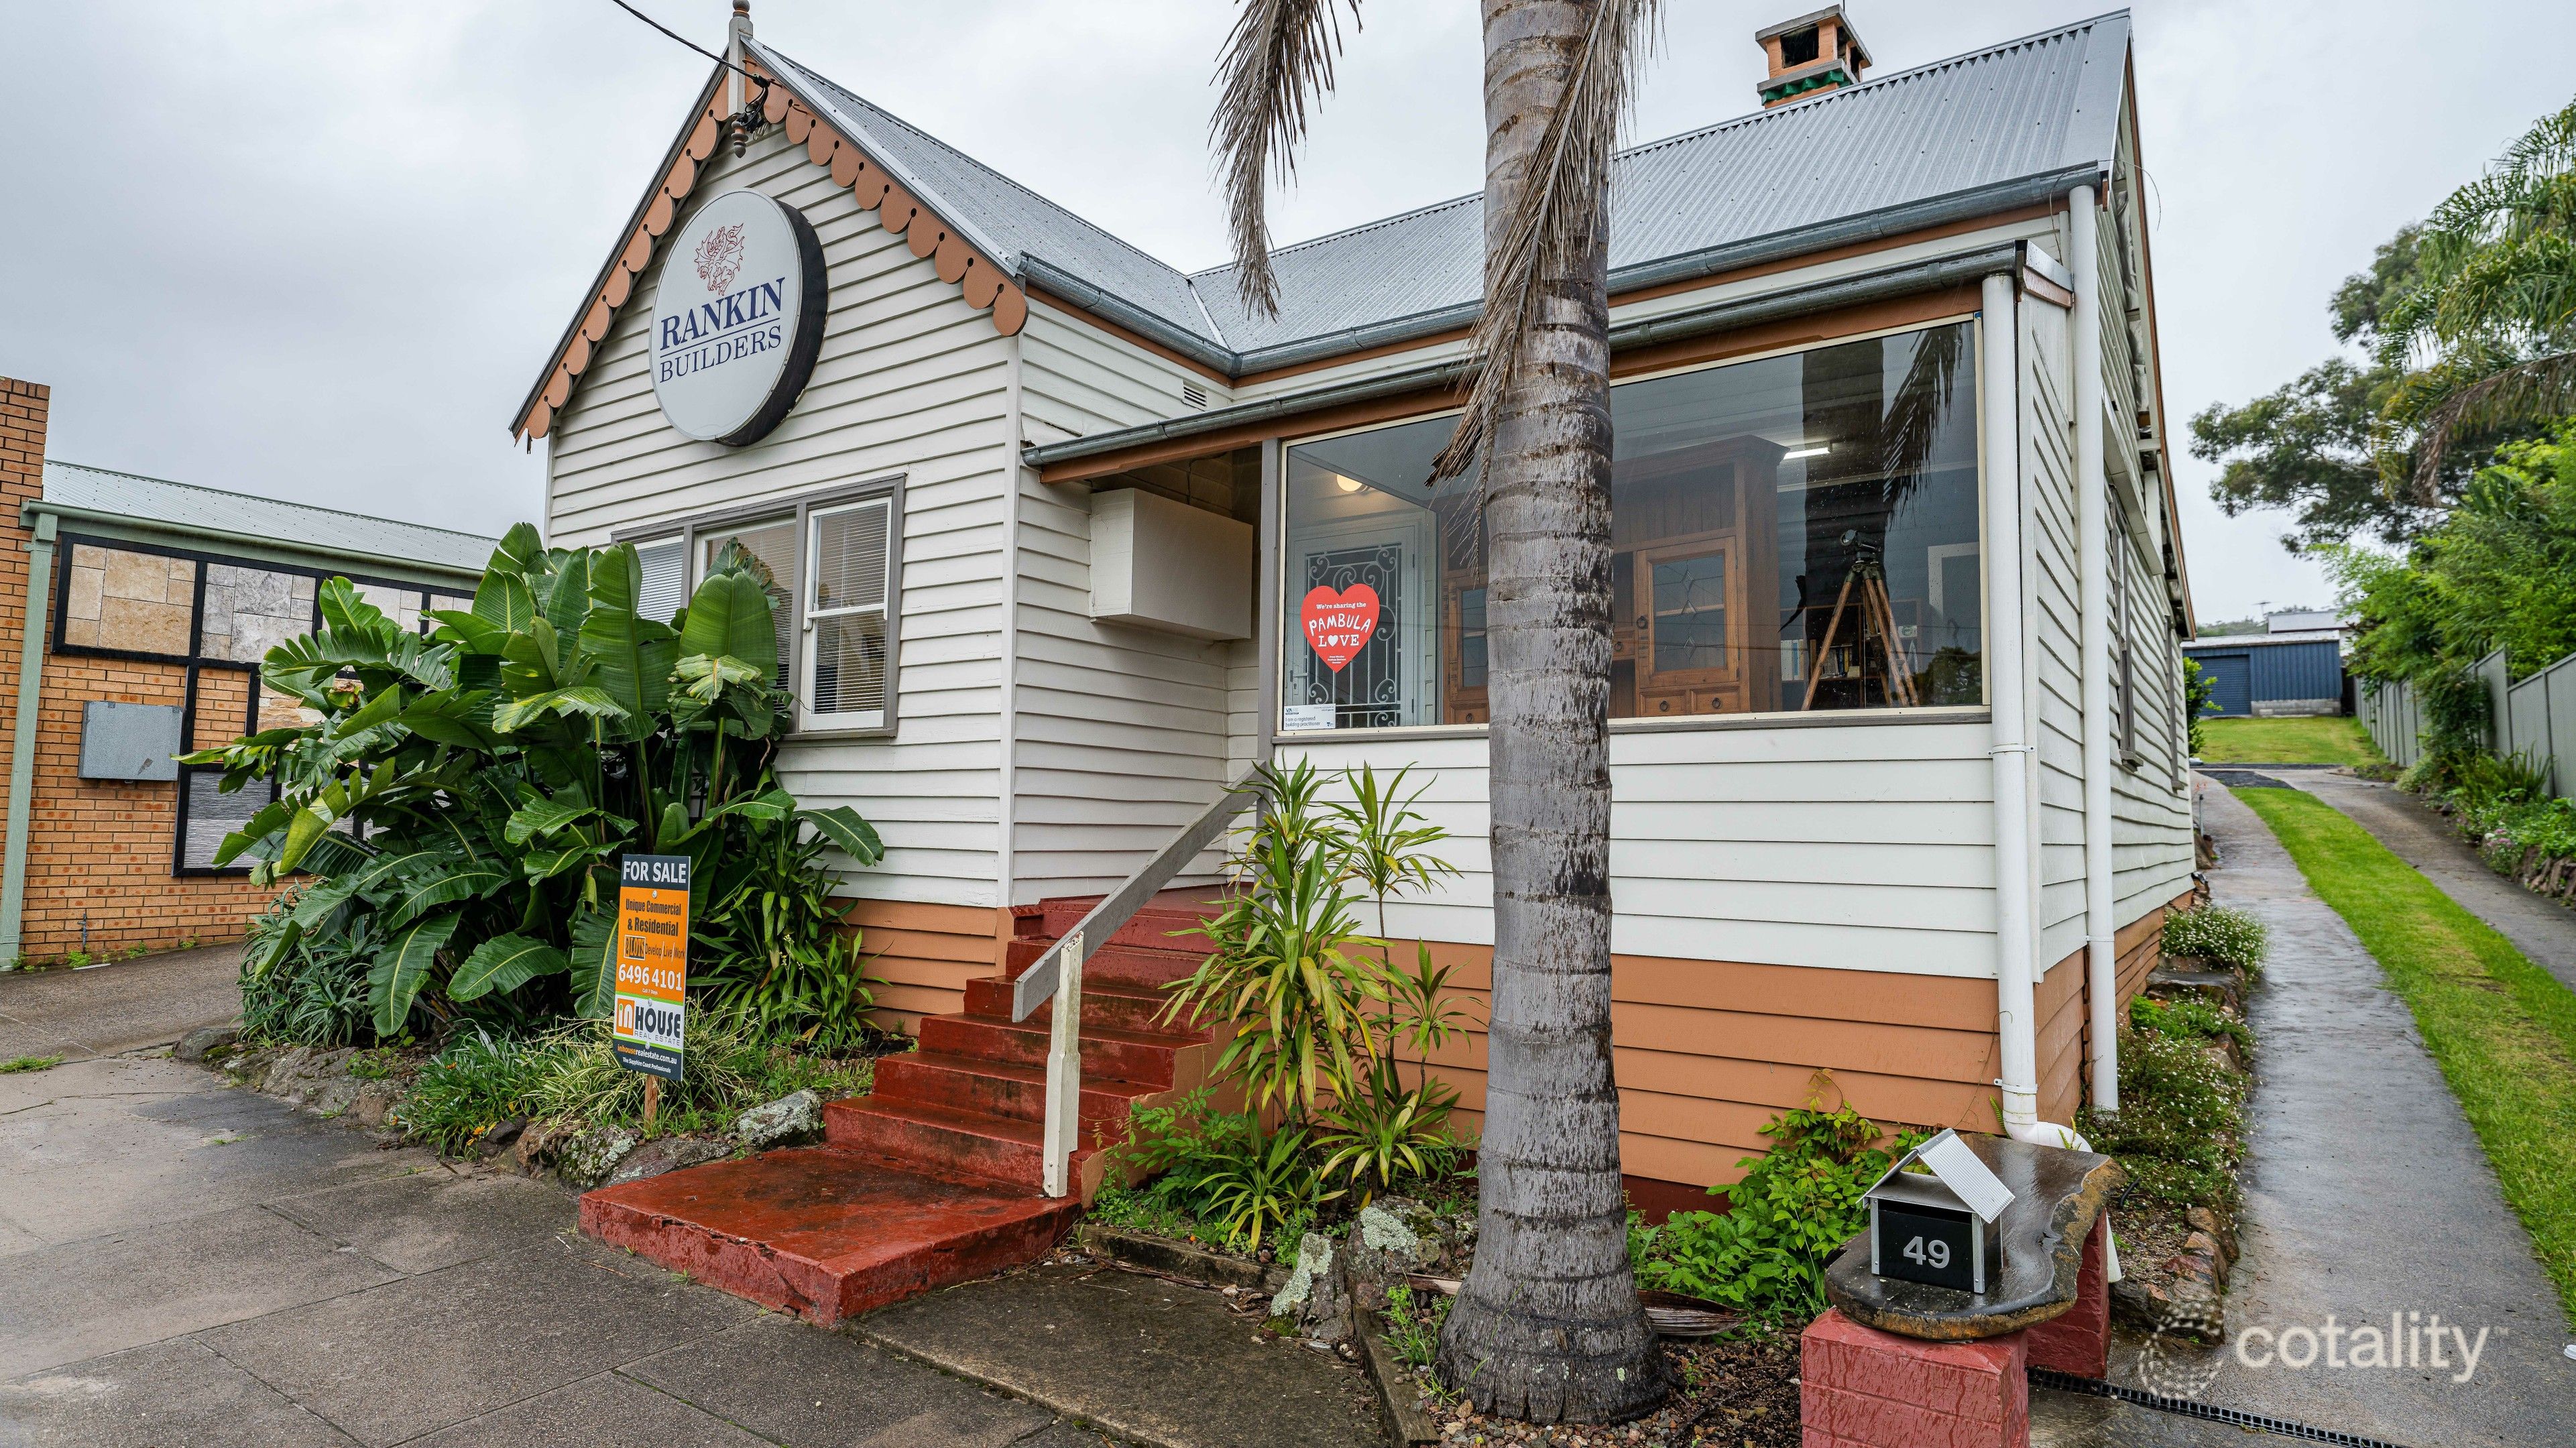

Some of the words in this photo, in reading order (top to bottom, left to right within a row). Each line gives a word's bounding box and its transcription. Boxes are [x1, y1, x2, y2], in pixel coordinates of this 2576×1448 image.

[660, 277, 785, 351] RANKIN
[660, 326, 781, 383] BUILDERS
[1309, 613, 1371, 636] PAMBULA
[623, 861, 649, 882] FOR
[652, 862, 687, 884] SALE
[626, 898, 645, 913] Unique
[646, 900, 681, 916] Commercial
[628, 918, 632, 930] &
[634, 917, 679, 937] Residential
[618, 963, 650, 985] 6496
[652, 970, 682, 991] 4101
[634, 1030, 651, 1039] REAL
[655, 1034, 680, 1046] ESTATE
[617, 1044, 677, 1065] inhouserealestate.com.au
[629, 1058, 642, 1067] Sapphire
[651, 1063, 671, 1073] Professionals
[1903, 1235, 1950, 1269] 49
